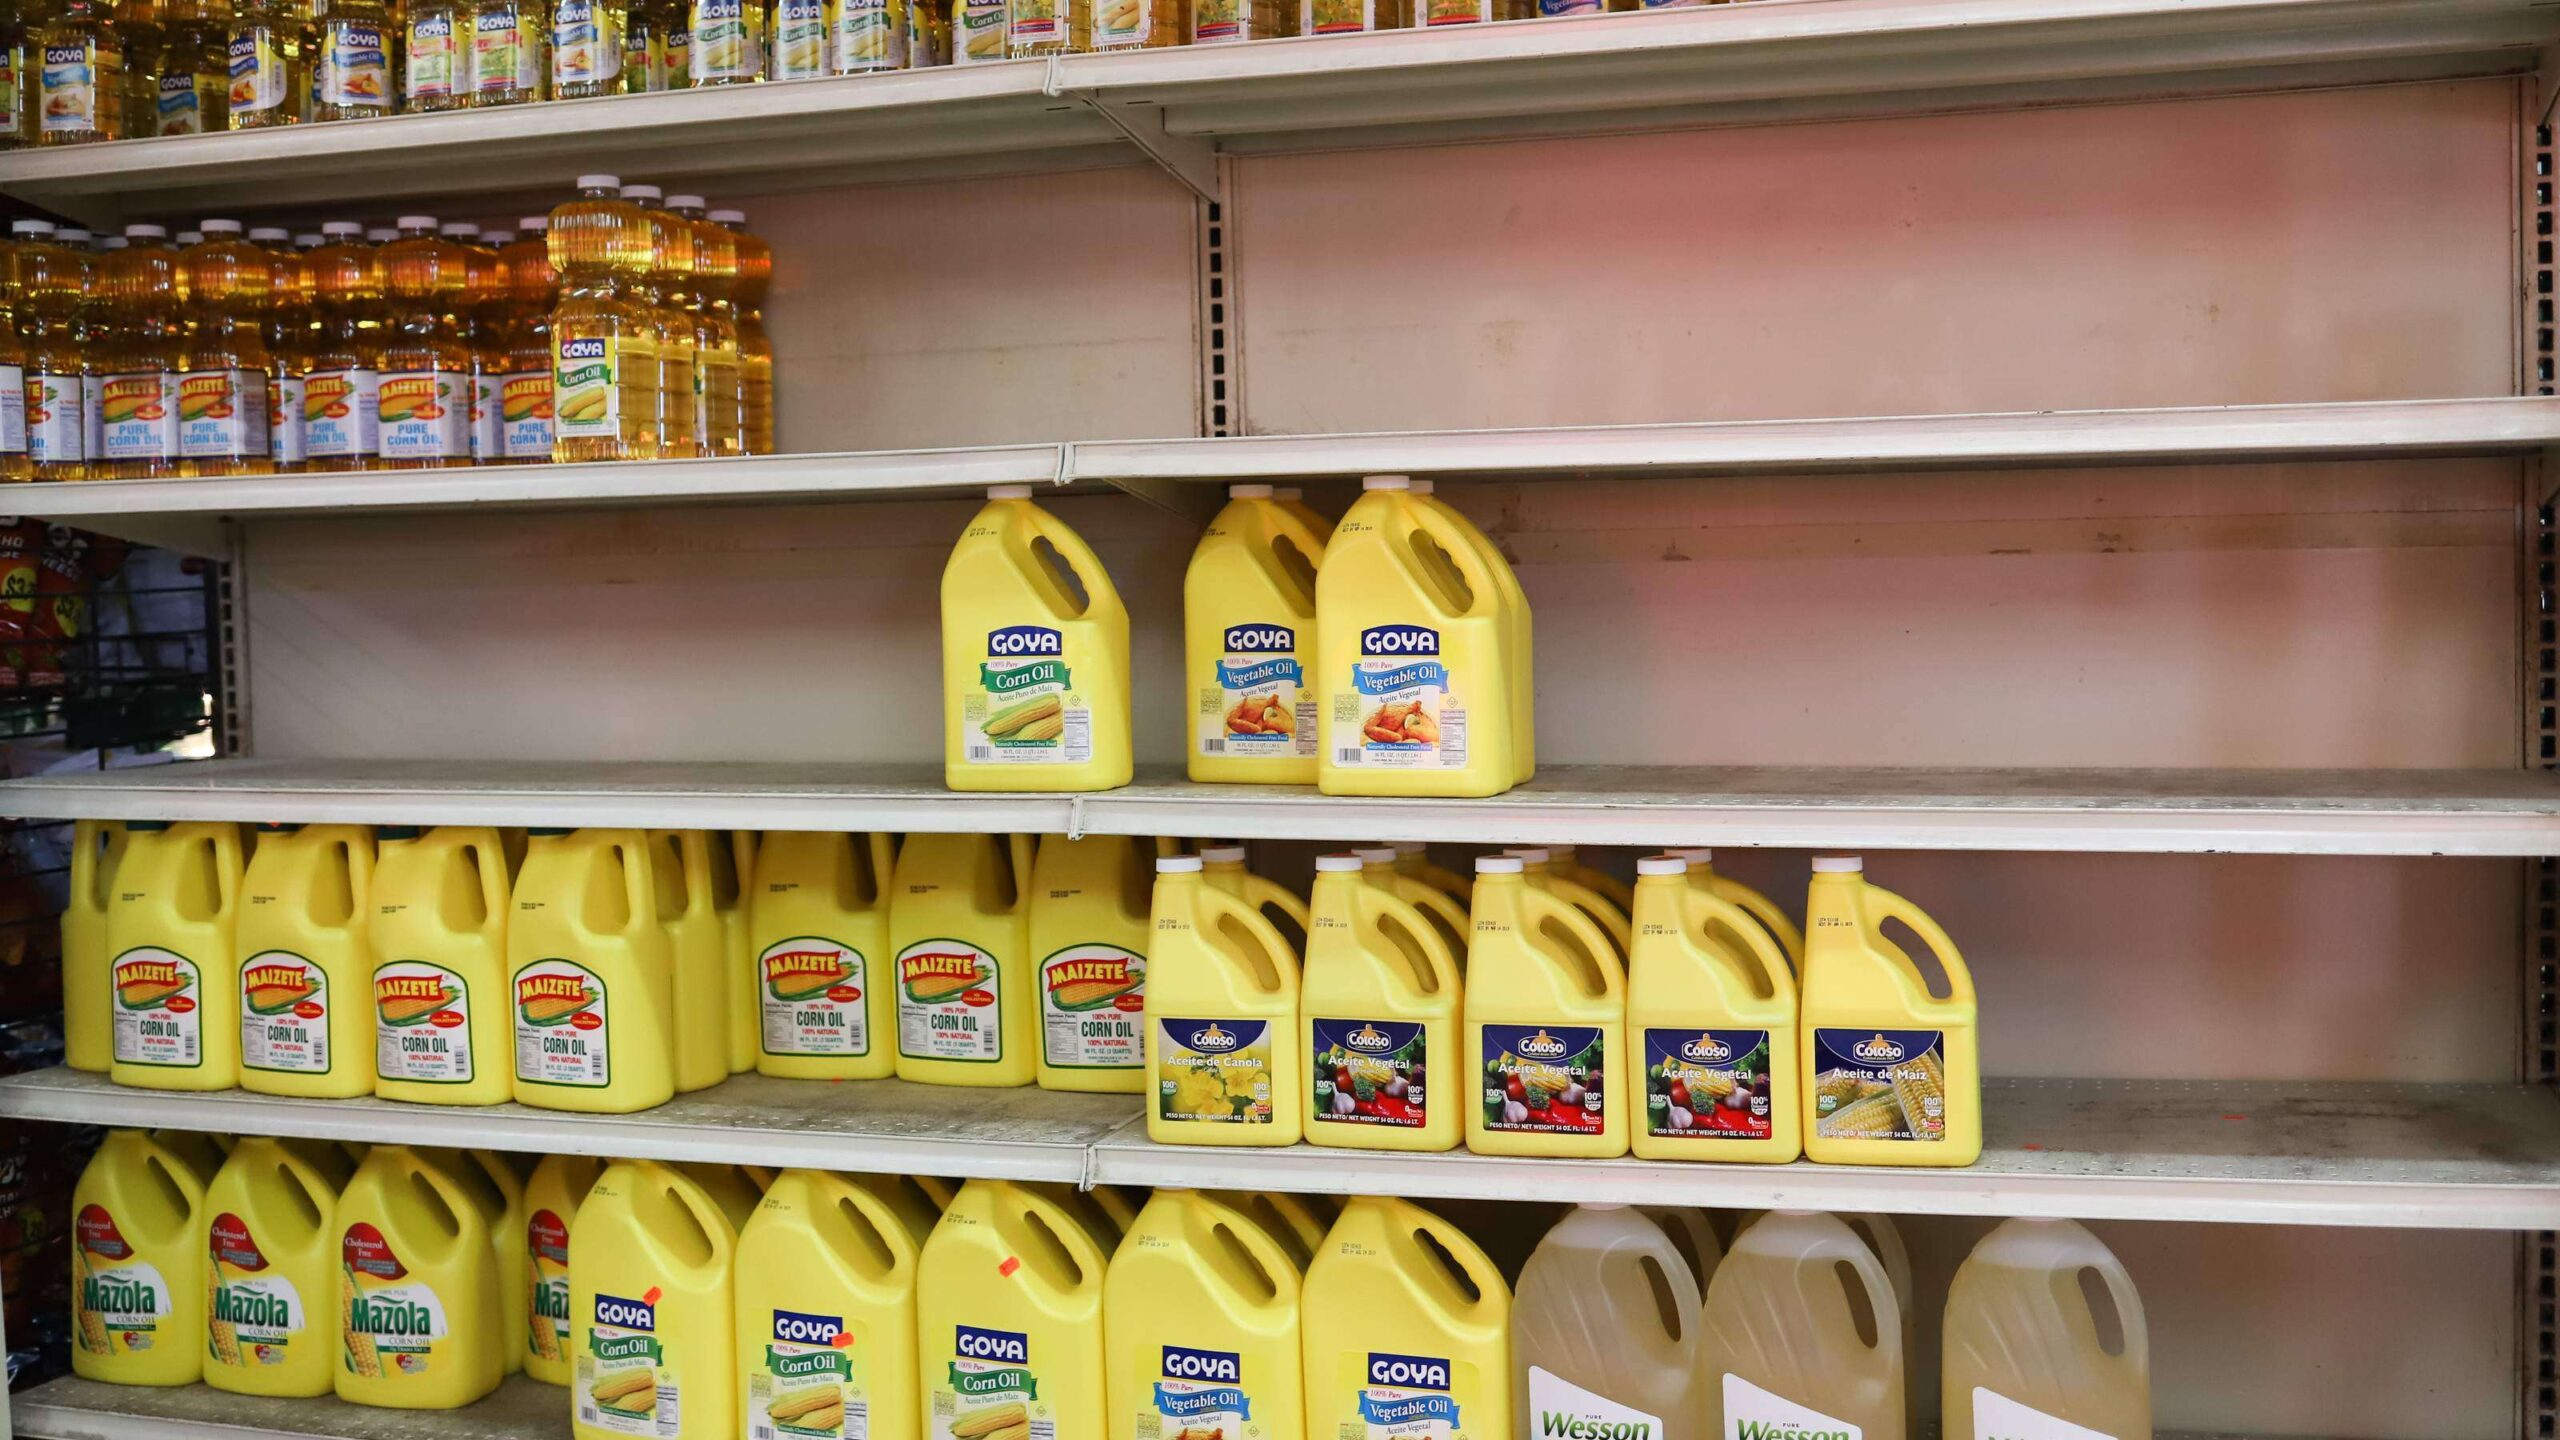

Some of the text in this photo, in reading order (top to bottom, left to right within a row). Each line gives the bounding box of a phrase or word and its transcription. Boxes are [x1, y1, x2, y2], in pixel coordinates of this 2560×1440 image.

[556, 9, 590, 22] GOYA
[702, 5, 740, 18] GOYA
[783, 6, 819, 18] GOYA
[480, 16, 514, 30] GOYA
[851, 19, 868, 30] Corn
[972, 14, 994, 27] Corn
[416, 24, 448, 36] GOYA
[705, 28, 723, 39] Corn
[339, 34, 378, 45] GOYA
[47, 50, 83, 62] GOYA
[230, 42, 254, 56] GOYA
[161, 77, 192, 89] GOYA
[562, 343, 603, 358] GOYA
[565, 367, 600, 384] Corn Oil
[381, 380, 433, 398] MAIZETE
[119, 425, 149, 434] PURE
[192, 423, 218, 432] PURE
[313, 422, 336, 432] PURE
[398, 424, 427, 433] PURE
[519, 422, 545, 432] PURE
[108, 435, 163, 446] CORN OIL
[184, 432, 229, 444] CORN OIL
[332, 431, 347, 442] OIL
[388, 434, 417, 445] CORN
[510, 434, 536, 445] CORN
[992, 634, 1057, 654] GOYA
[1228, 631, 1290, 650] GOYA
[1365, 632, 1434, 653] GOYA
[996, 665, 1054, 689] Corn Oil
[1227, 662, 1292, 686] Vegetable Oil
[1364, 666, 1437, 692] Vegetable Oil
[1015, 690, 1030, 698] Puro
[1258, 683, 1278, 694] Vegetal
[1379, 688, 1421, 704] Aceite Vegetal
[770, 956, 836, 976] MAIZETE
[906, 959, 972, 977] MAIZETE
[118, 964, 174, 984] MAIZETE
[248, 968, 303, 988] MAIZETE
[1051, 964, 1124, 986] MAIZETE
[378, 980, 439, 999] MAIZETE
[522, 978, 580, 998] MAIZETE
[796, 1011, 845, 1027] CORN OIL
[931, 1014, 978, 1032] CORN OIL
[140, 1021, 180, 1037] CORN OIL
[268, 1025, 308, 1044] CORN OIL
[1082, 1022, 1134, 1037] CORN OIL
[402, 1036, 449, 1053] CORN OIL
[544, 1036, 587, 1055] CORN OIL
[1194, 1034, 1234, 1046] Coloso
[1349, 1033, 1389, 1046] Coloso
[1521, 1040, 1564, 1053] Coloso
[1684, 1044, 1728, 1056] Coloso
[1855, 1044, 1902, 1057] Coloso
[1168, 1056, 1263, 1067] Aceite de Canola
[1328, 1056, 1409, 1070] Aceite Vegetal
[1498, 1063, 1586, 1077] Aceite Vegetal
[1662, 1068, 1751, 1081] Aceite Vegetal
[1832, 1069, 1893, 1079] Aceite de
[345, 1238, 383, 1249] Cholesterol
[84, 1278, 156, 1313] Mazola
[216, 1287, 289, 1327] Mazola
[352, 1298, 431, 1336] Mazola
[597, 1302, 650, 1328] GOYA
[248, 1328, 271, 1337] CORN
[776, 1318, 839, 1342] GOYA
[389, 1336, 430, 1345] CORN OIL
[959, 1334, 1023, 1359] GOYA
[601, 1340, 648, 1356] Corn Oil
[780, 1356, 835, 1373] Corn Oil
[1166, 1354, 1236, 1379] GOYA
[1372, 1360, 1446, 1386] GOYA
[964, 1373, 1020, 1391] Corn Oil
[1388, 1391, 1402, 1399] Pure
[1164, 1393, 1238, 1414] Vegetable Oil
[1370, 1400, 1448, 1422] Vegetable Oil
[1200, 1414, 1222, 1424] Vegetal
[1542, 1410, 1650, 1440] Wesson
[1386, 1422, 1430, 1435] Aceite Vegetal
